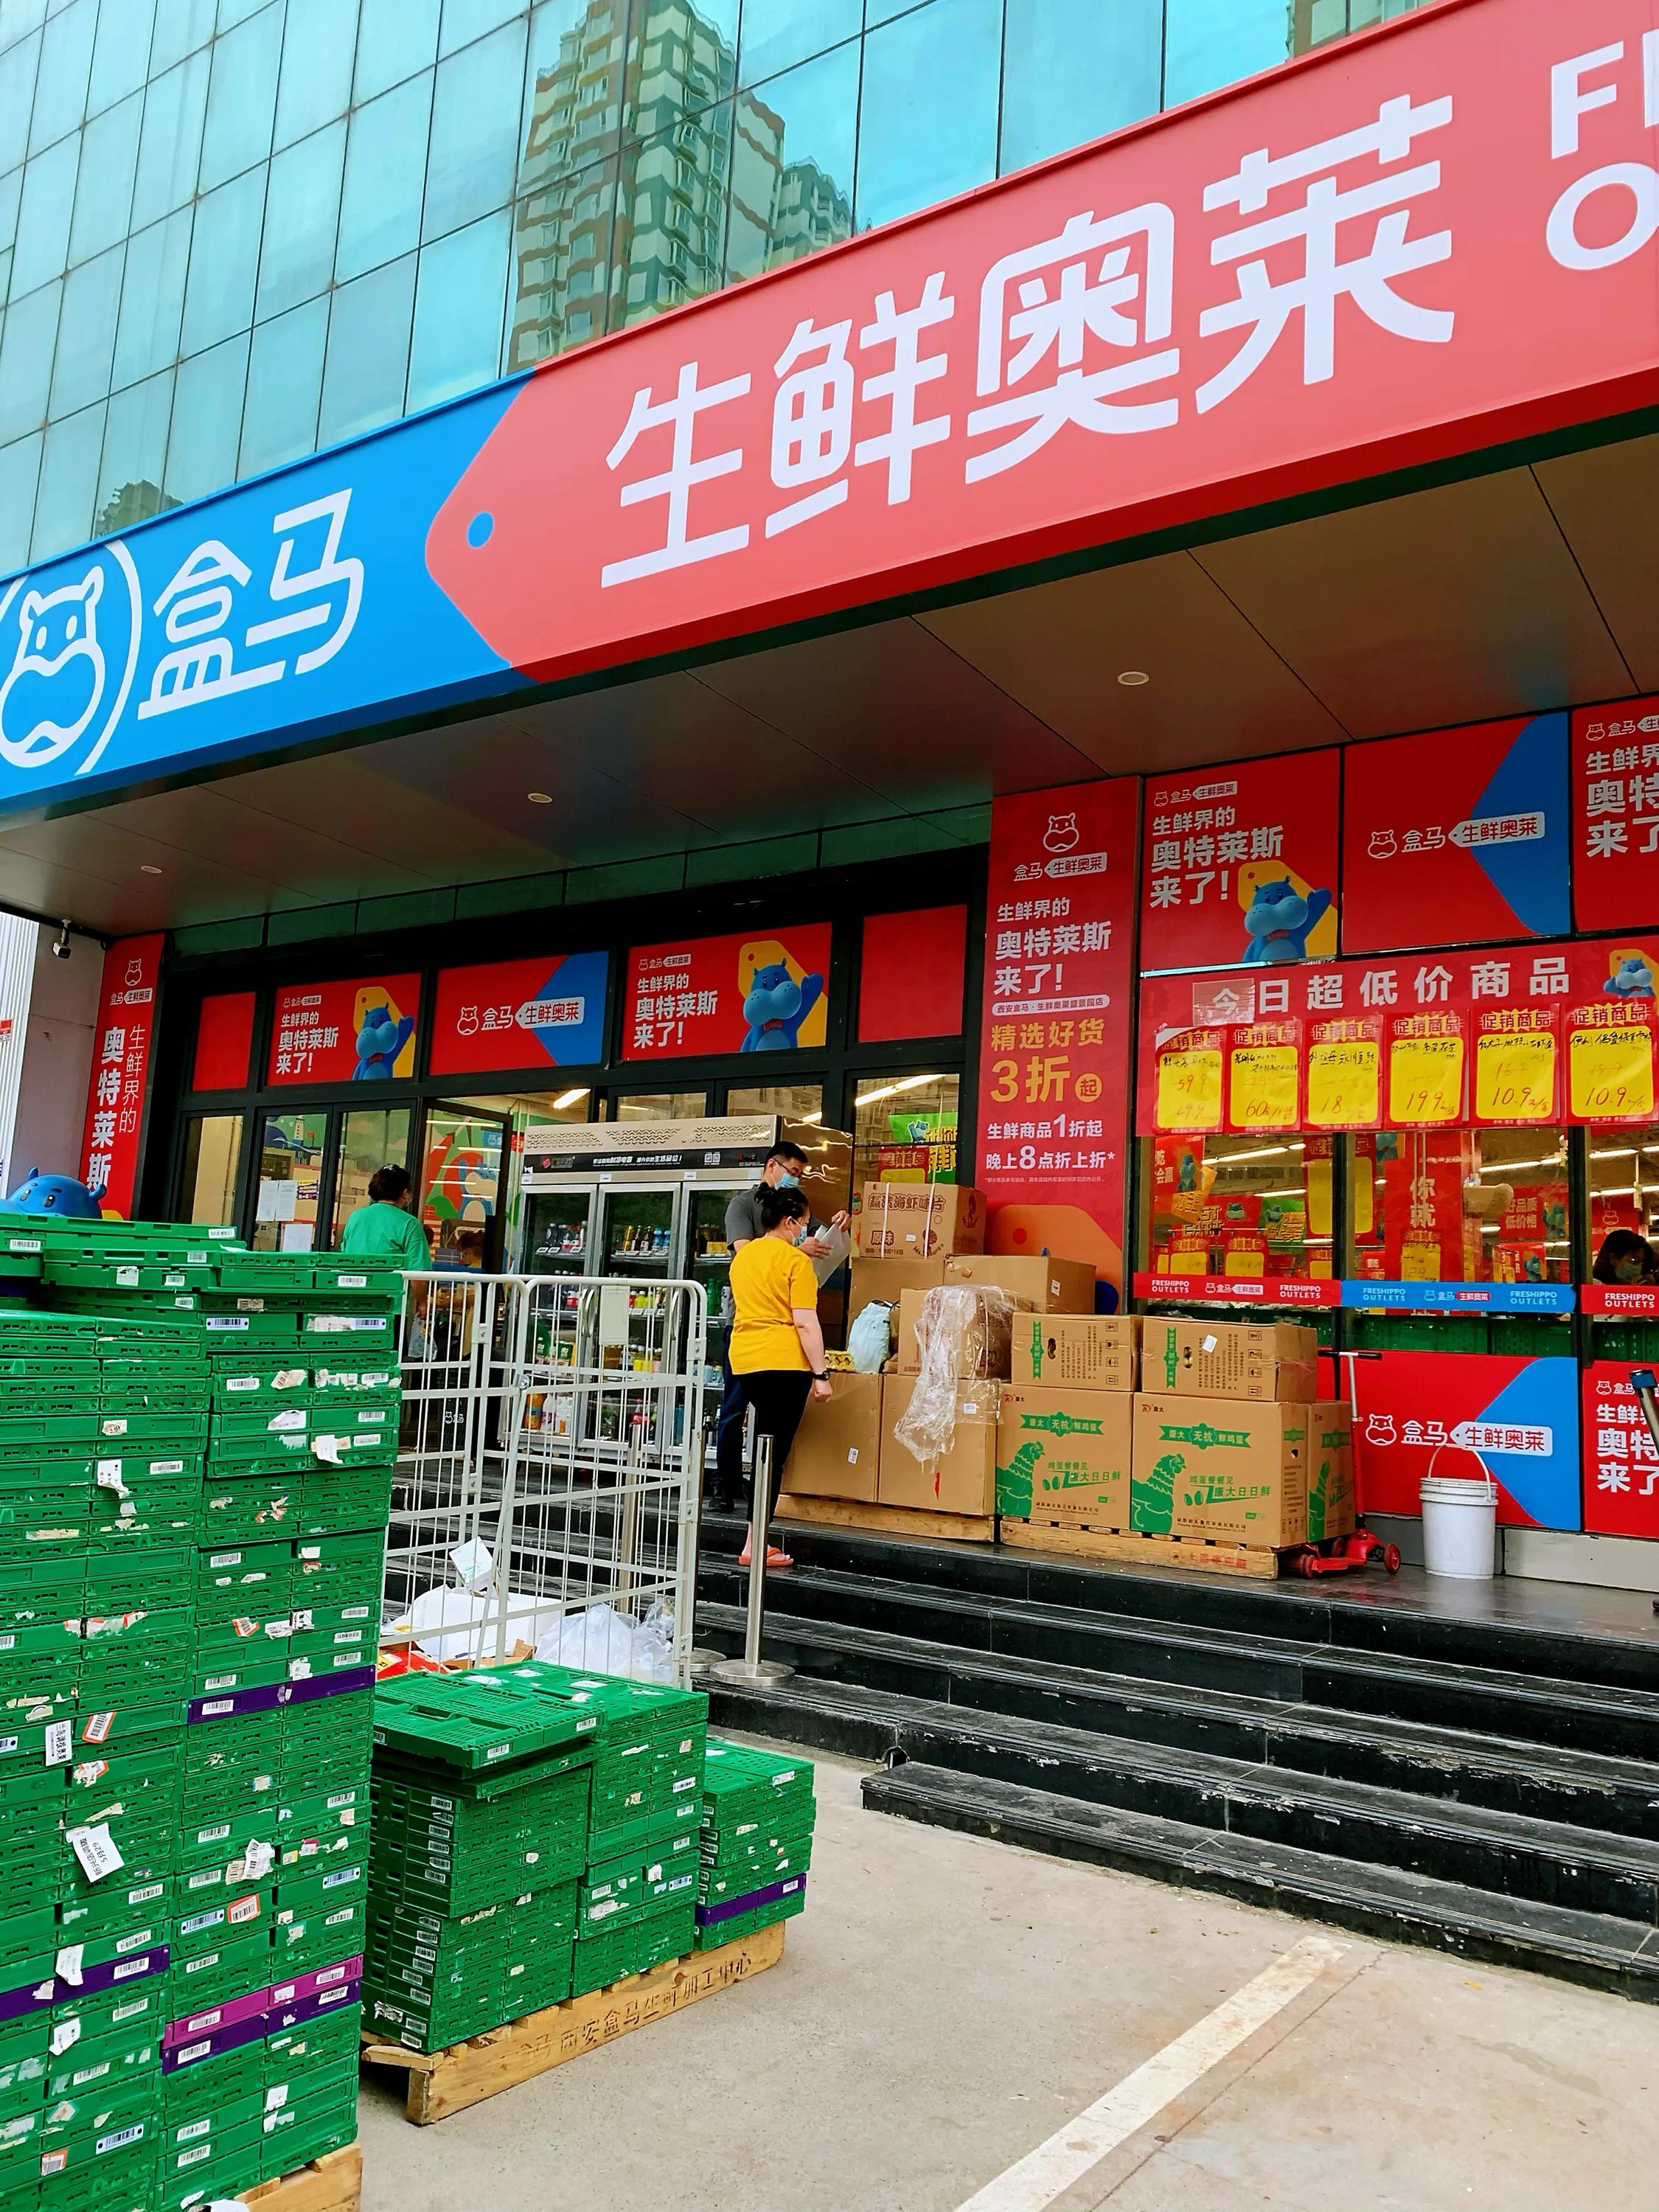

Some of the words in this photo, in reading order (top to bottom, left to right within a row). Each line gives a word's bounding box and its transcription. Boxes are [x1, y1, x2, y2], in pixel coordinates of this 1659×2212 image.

[1551, 31, 1659, 159] F
[601, 94, 1455, 588] 生鲜奥莱
[138, 487, 364, 720] 盒马
[1607, 721, 1635, 737] 盒马
[1170, 790, 1192, 804] 盒马
[1199, 784, 1234, 798] 生鲜奥莱
[1152, 806, 1235, 835] 生鲜界的
[1402, 826, 1446, 852] 盒马
[1461, 816, 1538, 844] 生鲜奥莱
[1151, 825, 1283, 872] 奥特莱斯
[1014, 863, 1043, 881] 盒马
[1053, 856, 1102, 875] 生鲜奥莱
[997, 897, 1070, 922] 生鲜界的
[995, 921, 1111, 960] 奥特莱斯
[637, 973, 689, 993] 生鲜界的
[1212, 956, 1569, 1015] 今日超低价商品
[282, 1011, 319, 1026] 生鲜界的
[481, 1005, 514, 1030] 盒马
[524, 1001, 580, 1025] 生鲜奥莱
[635, 990, 718, 1022] 奥特莱斯
[1482, 1012, 1550, 1029] 促销商品
[1574, 1004, 1646, 1024] 促销商品
[279, 1027, 338, 1051] 奥特莱斯
[991, 1018, 1105, 1051] 精选好货
[1395, 1018, 1460, 1034] 促销商品
[119, 1023, 145, 1133] 生鲜界的
[990, 1055, 1071, 1103] 3折
[86, 1027, 126, 1189] 奥特莱斯
[987, 1114, 1103, 1139] 生鲜商品1折起
[1604, 1293, 1655, 1301] FRESHIPPO
[1613, 1383, 1635, 1394] 盒马
[1402, 1420, 1448, 1446] 盒马
[1464, 1426, 1545, 1451] 生鲜奥莱
